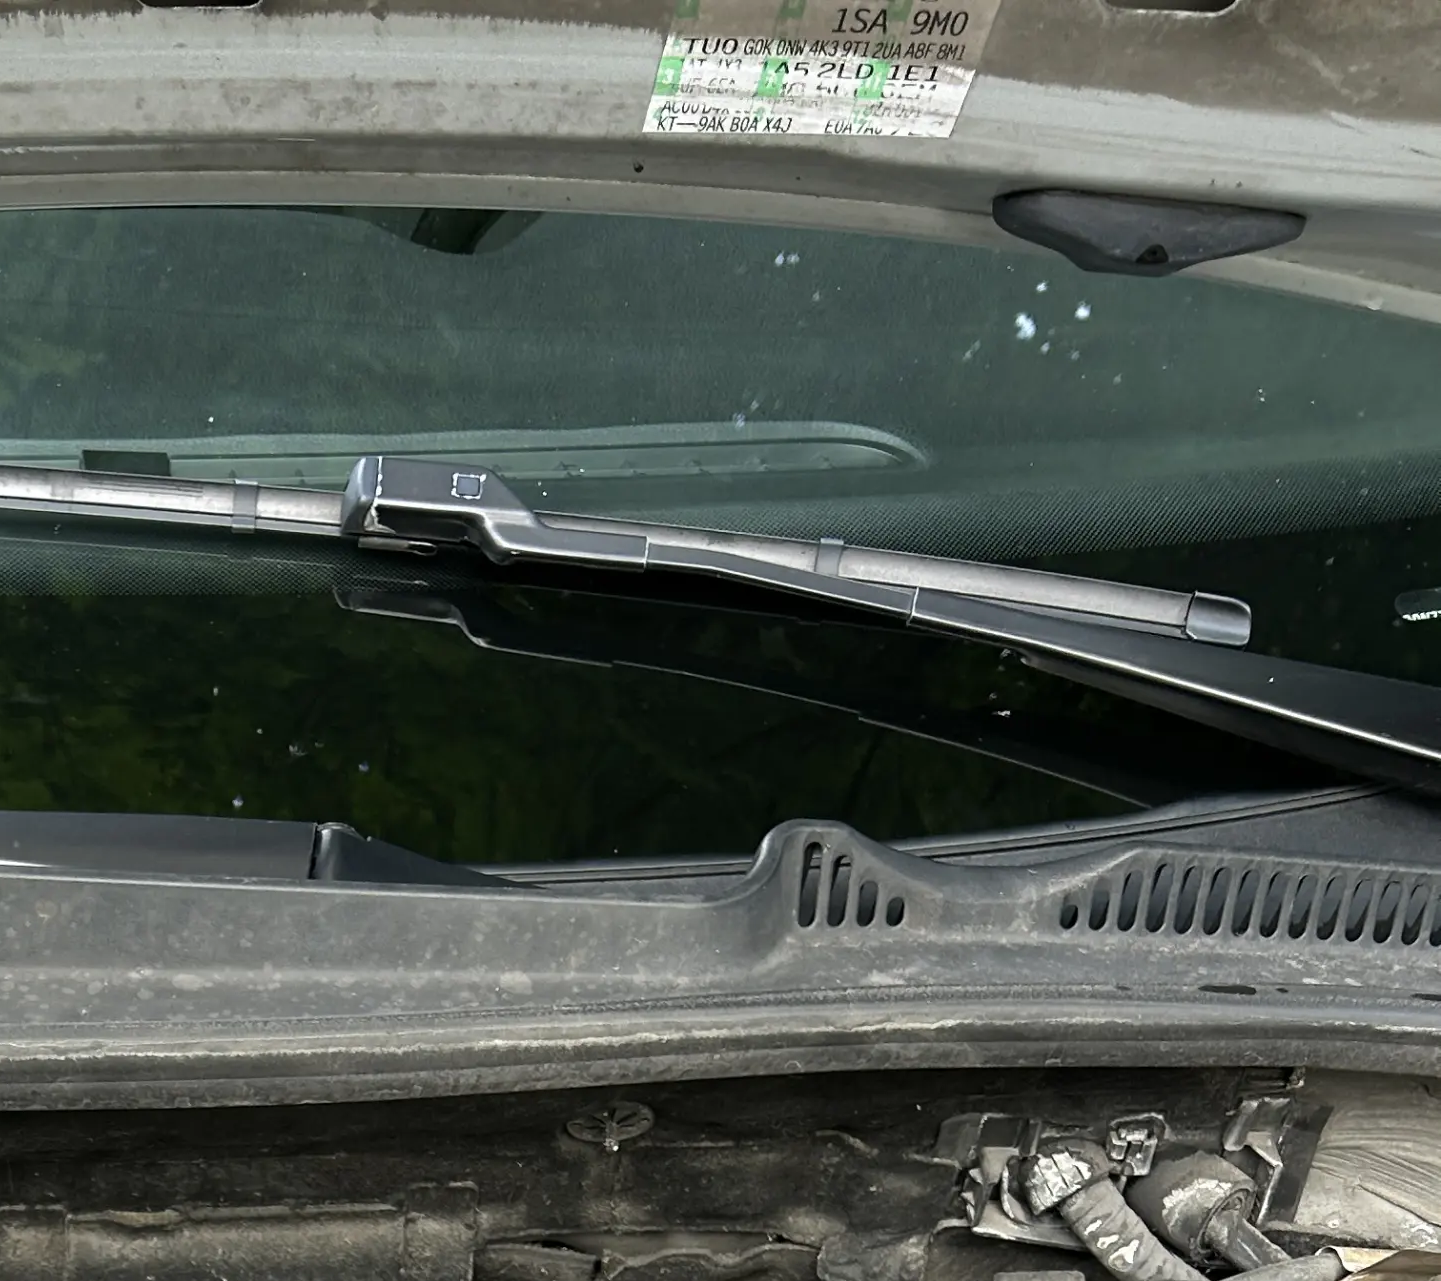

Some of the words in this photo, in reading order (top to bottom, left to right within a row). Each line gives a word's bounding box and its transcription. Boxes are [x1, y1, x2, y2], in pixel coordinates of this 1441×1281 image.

[832, 8, 888, 35] 1SA
[808, 40, 839, 57] 4K3
[872, 42, 902, 59] 2UA
